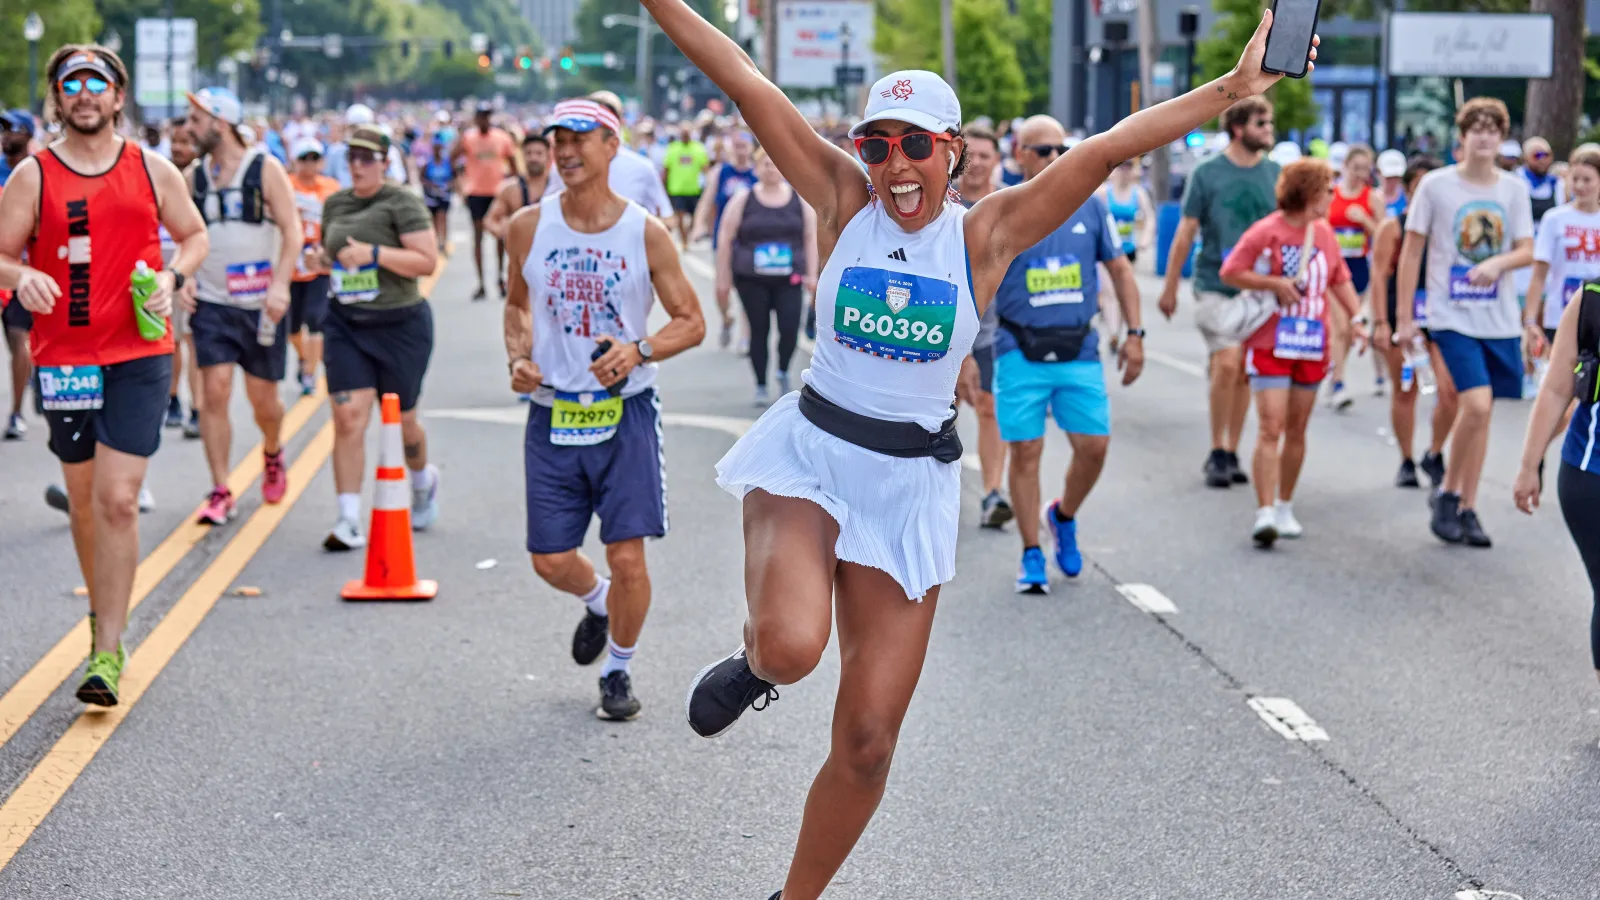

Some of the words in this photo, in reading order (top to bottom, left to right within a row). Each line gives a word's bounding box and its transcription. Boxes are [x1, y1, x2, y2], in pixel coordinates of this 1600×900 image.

[67, 197, 91, 327] IRONMAN
[566, 279, 604, 292] ROAD
[566, 291, 604, 304] RACE
[843, 306, 944, 345] P60396
[560, 408, 616, 423] T72979
